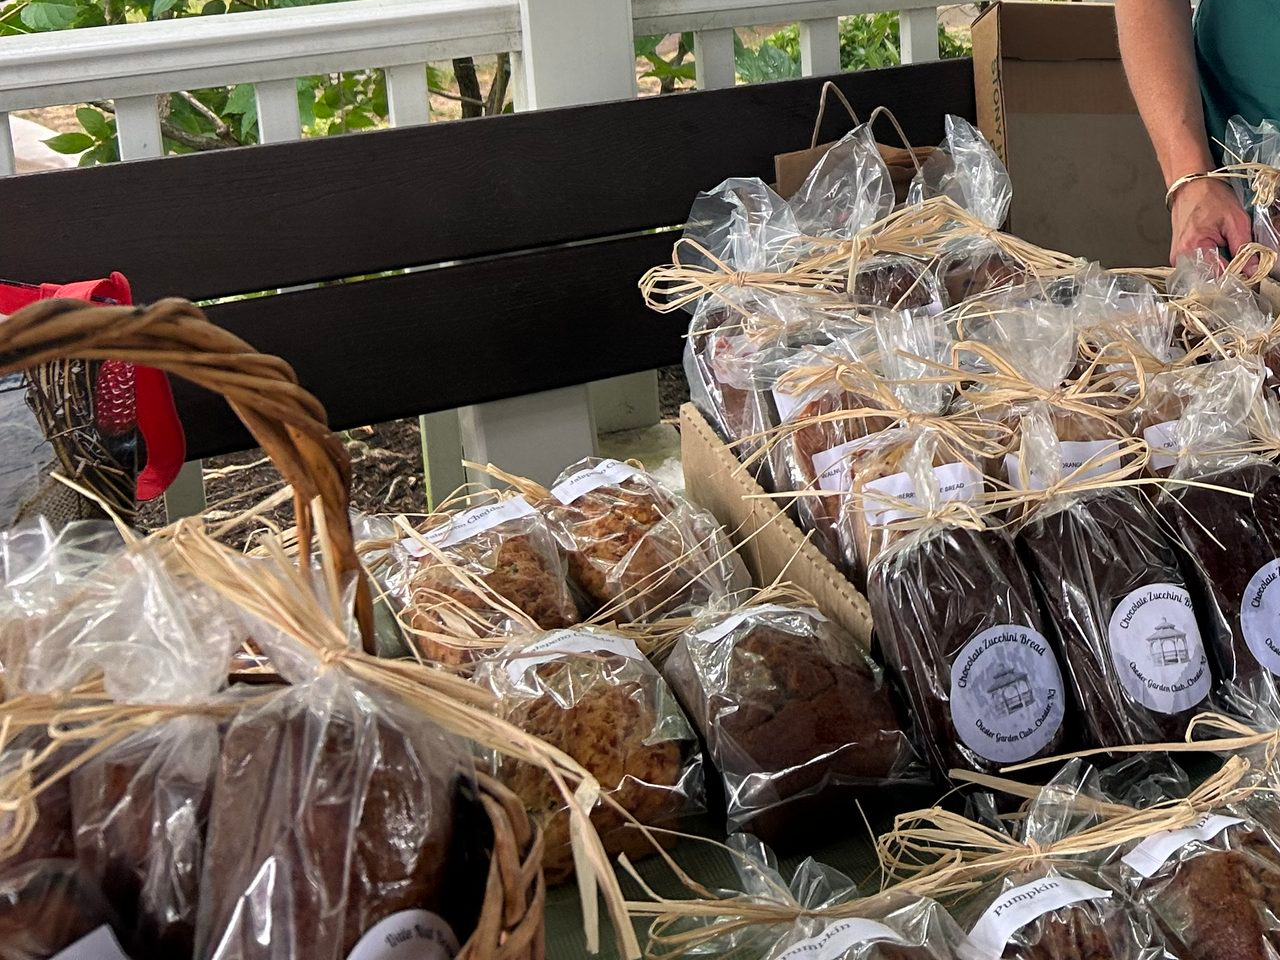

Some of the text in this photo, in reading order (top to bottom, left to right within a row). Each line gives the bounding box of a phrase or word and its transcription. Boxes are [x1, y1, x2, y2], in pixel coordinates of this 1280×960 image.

[944, 482, 965, 492] BREAD
[1251, 572, 1278, 608] Chocolate
[1119, 597, 1148, 629] Chocolate
[1147, 590, 1183, 603] Zucchini
[958, 632, 1047, 688] Chocolate Zucchini Bread
[1129, 661, 1148, 682] Chester
[1147, 678, 1171, 693] Garden
[975, 718, 996, 738] Chester
[995, 732, 1019, 743] Garden
[992, 880, 1060, 918] Pumpkin
